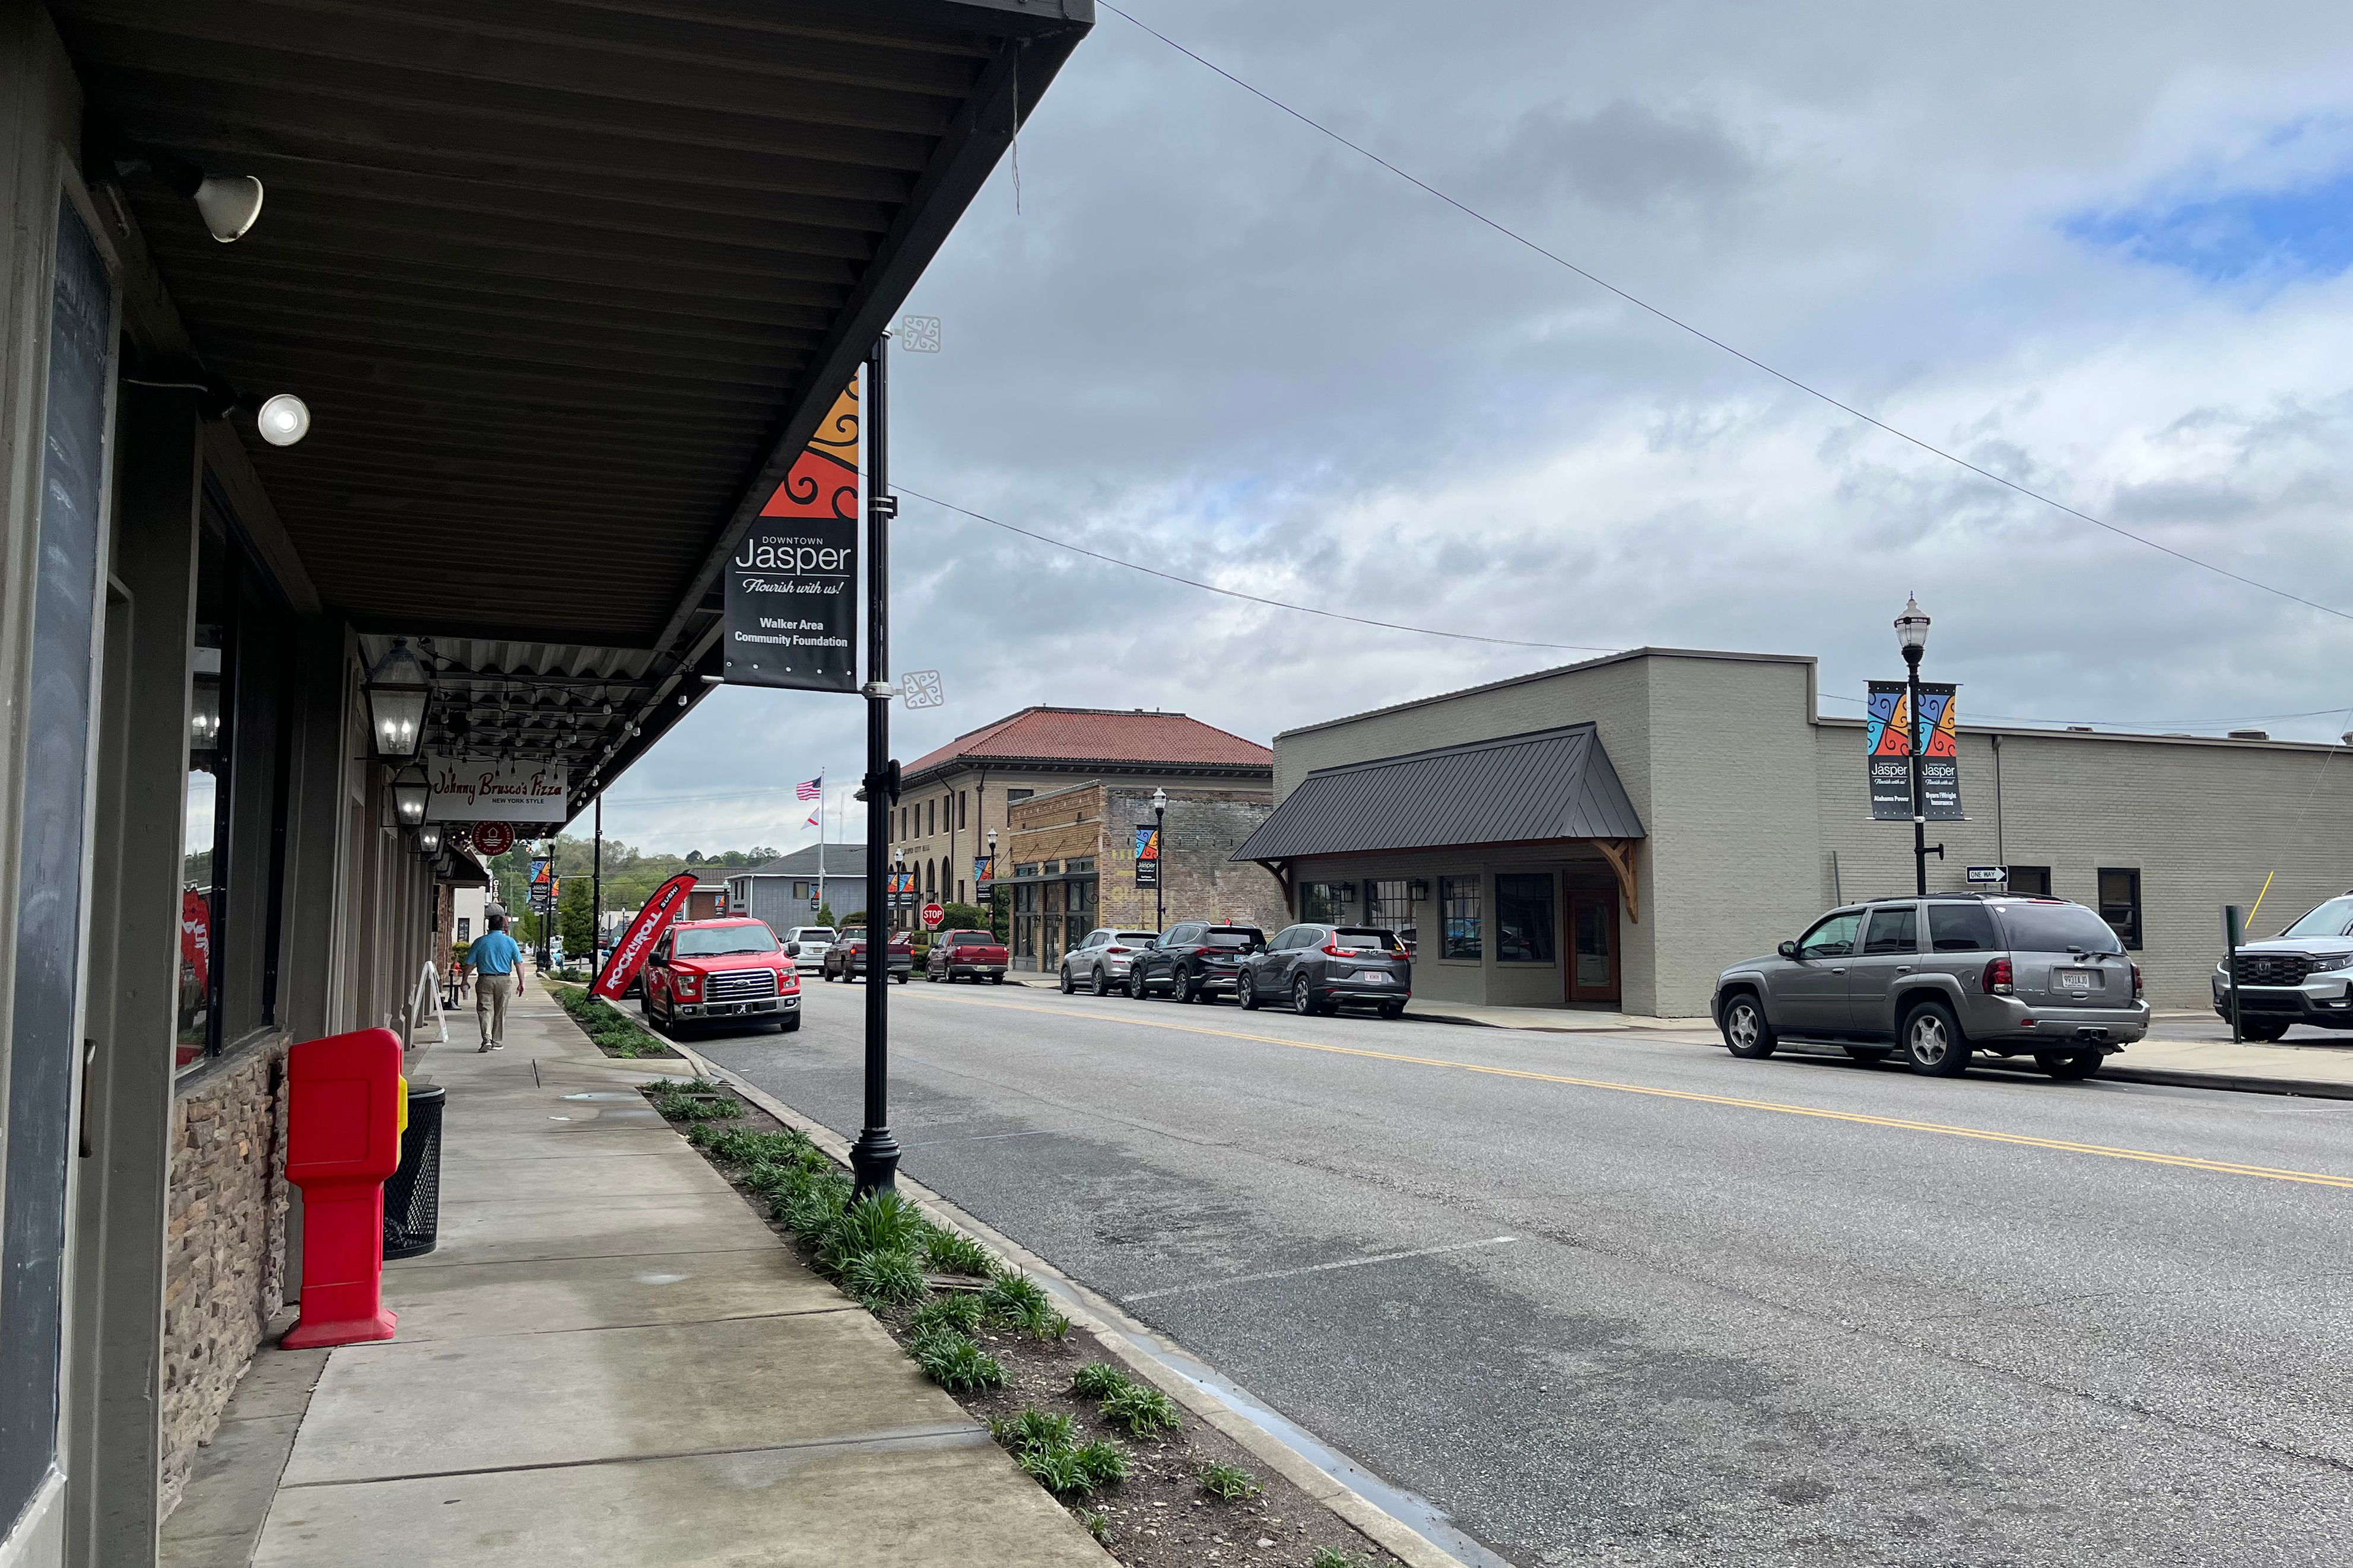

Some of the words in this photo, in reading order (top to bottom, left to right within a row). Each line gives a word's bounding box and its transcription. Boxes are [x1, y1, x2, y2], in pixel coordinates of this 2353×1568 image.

[762, 536, 823, 545] DOWNTOWN
[735, 539, 852, 576] Jasper
[742, 578, 795, 593] Flourish
[796, 581, 823, 594] with
[824, 581, 844, 594] us!
[760, 617, 798, 629] Walker
[799, 619, 824, 631] Area
[735, 631, 791, 647] Community
[793, 635, 848, 647] Foundation
[1871, 763, 1908, 777] Jasper
[1922, 764, 1955, 778] Jasper
[434, 771, 475, 806] Johnny
[478, 772, 527, 796] Brusco's
[531, 772, 562, 796] Pizza
[661, 886, 678, 908] SUSHI
[923, 910, 942, 918] STOP
